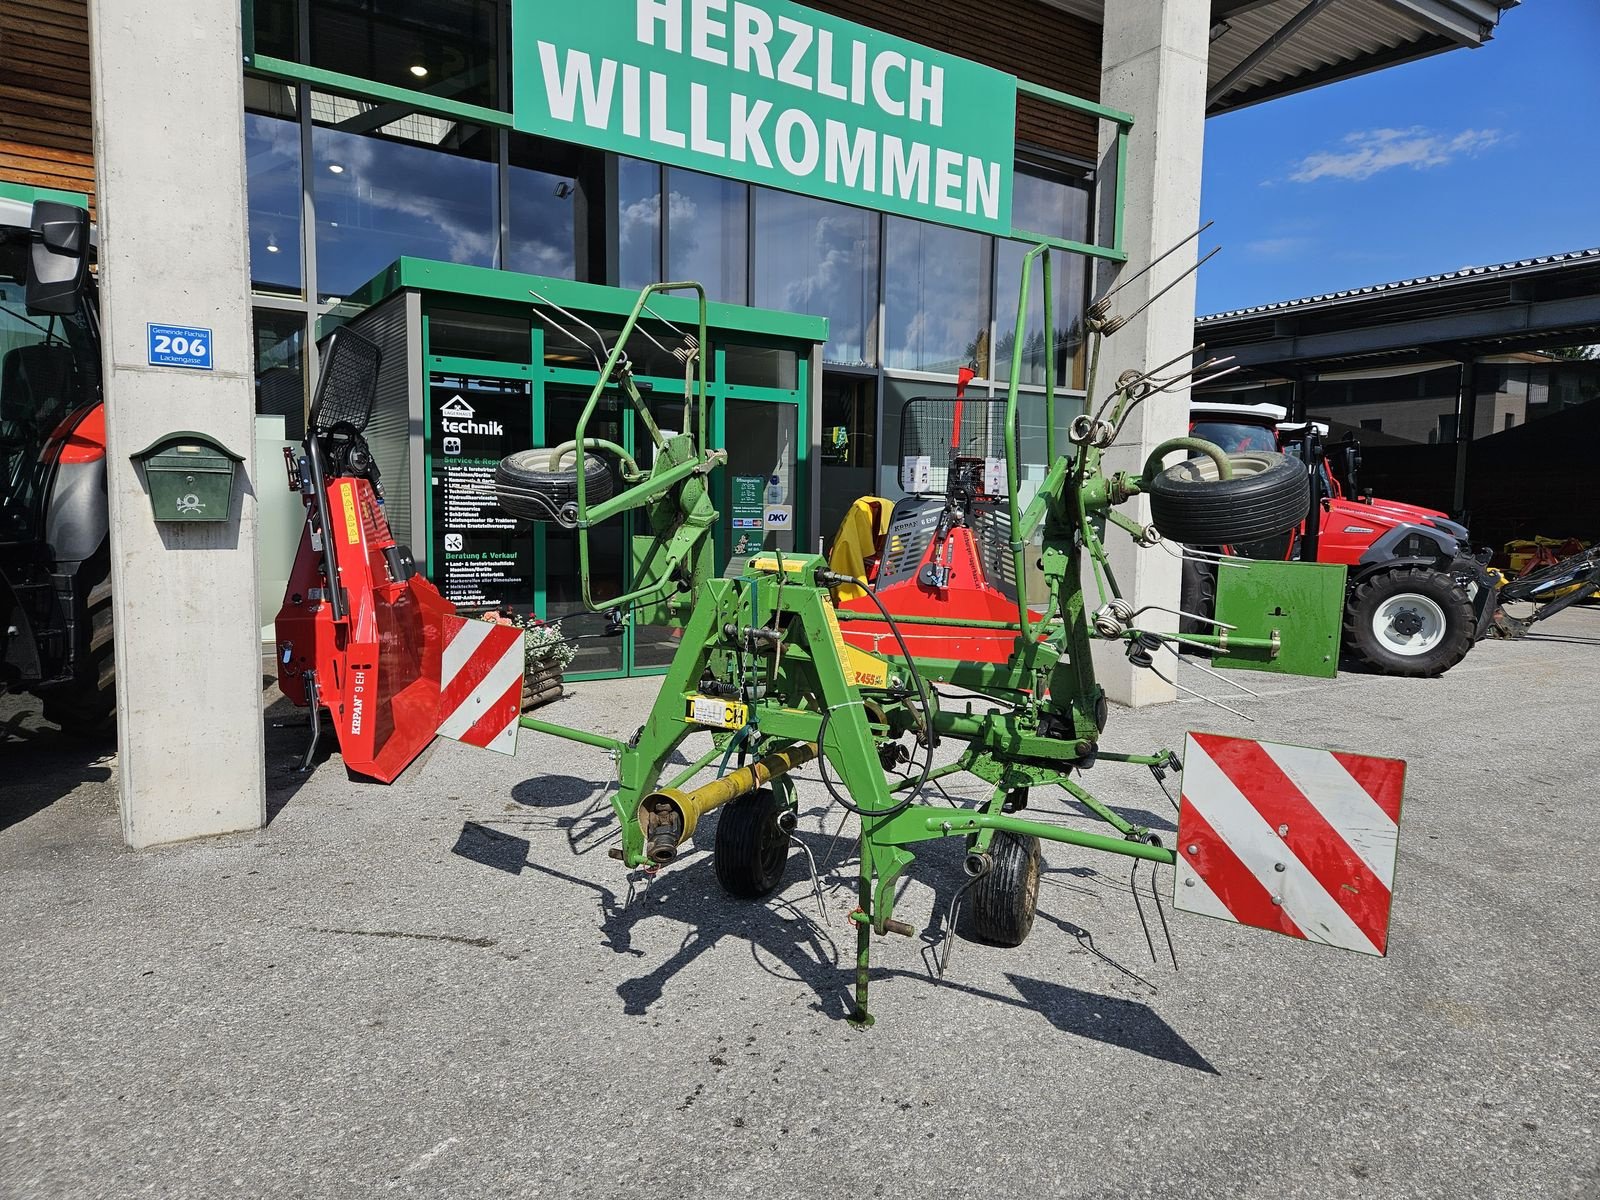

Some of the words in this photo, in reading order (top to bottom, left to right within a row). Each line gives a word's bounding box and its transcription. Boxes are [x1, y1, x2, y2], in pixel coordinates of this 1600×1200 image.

[637, 0, 944, 127] HERZLICH
[537, 40, 1001, 220] WILLKOMMEN
[152, 328, 184, 336] Gemeinde
[154, 335, 206, 356] 206
[160, 355, 201, 364] Lackengasse
[441, 418, 503, 436] technik
[444, 456, 472, 464] Service
[355, 672, 364, 684] EH
